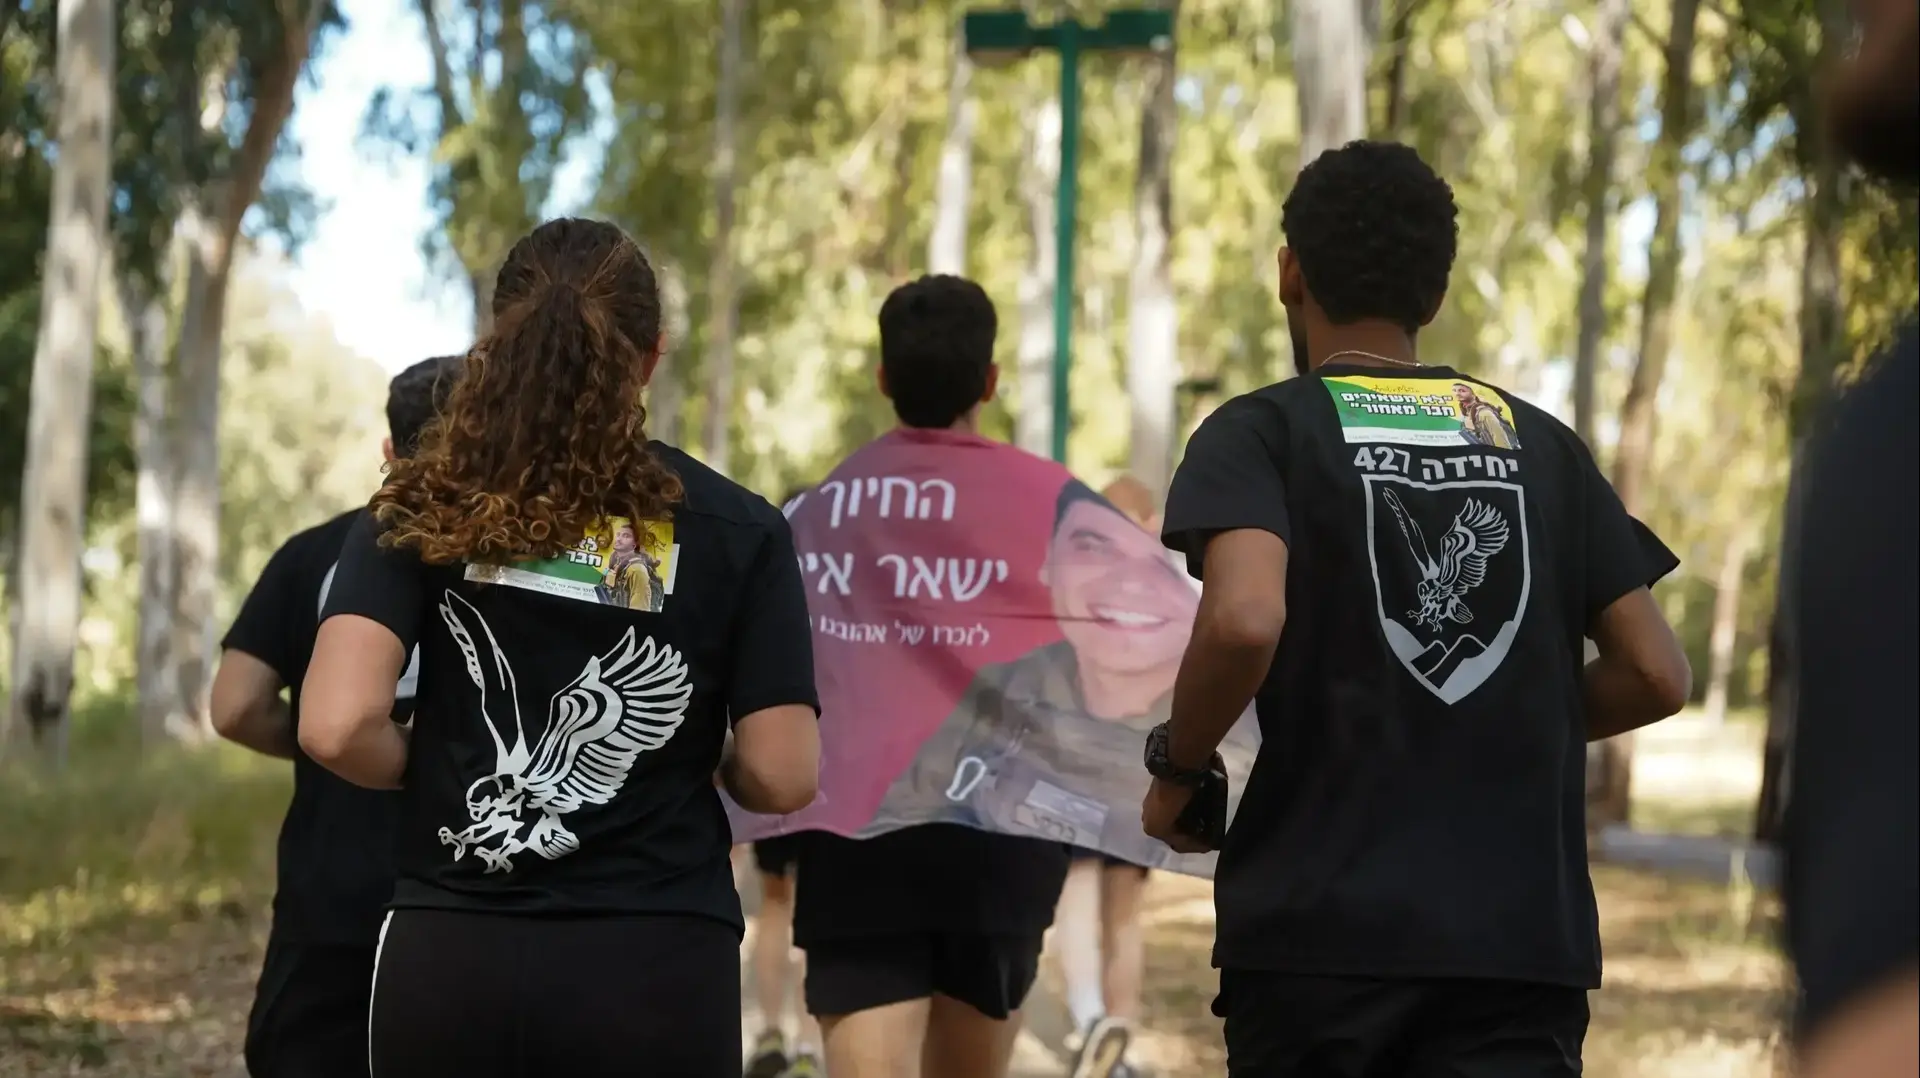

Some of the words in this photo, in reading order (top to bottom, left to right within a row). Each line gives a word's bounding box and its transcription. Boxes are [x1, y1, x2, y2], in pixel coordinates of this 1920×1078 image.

[1340, 392, 1417, 403] משאירים
[1420, 405, 1455, 417] חבר
[1353, 446, 1410, 475] 427
[1421, 454, 1519, 481] יחידה
[819, 476, 956, 528] החיוך
[565, 550, 602, 567] חבר
[796, 552, 854, 595] אי
[876, 554, 1009, 602] ישאר
[819, 613, 887, 644] אהובנו
[894, 618, 926, 646] של
[932, 622, 990, 647] לזכרו
